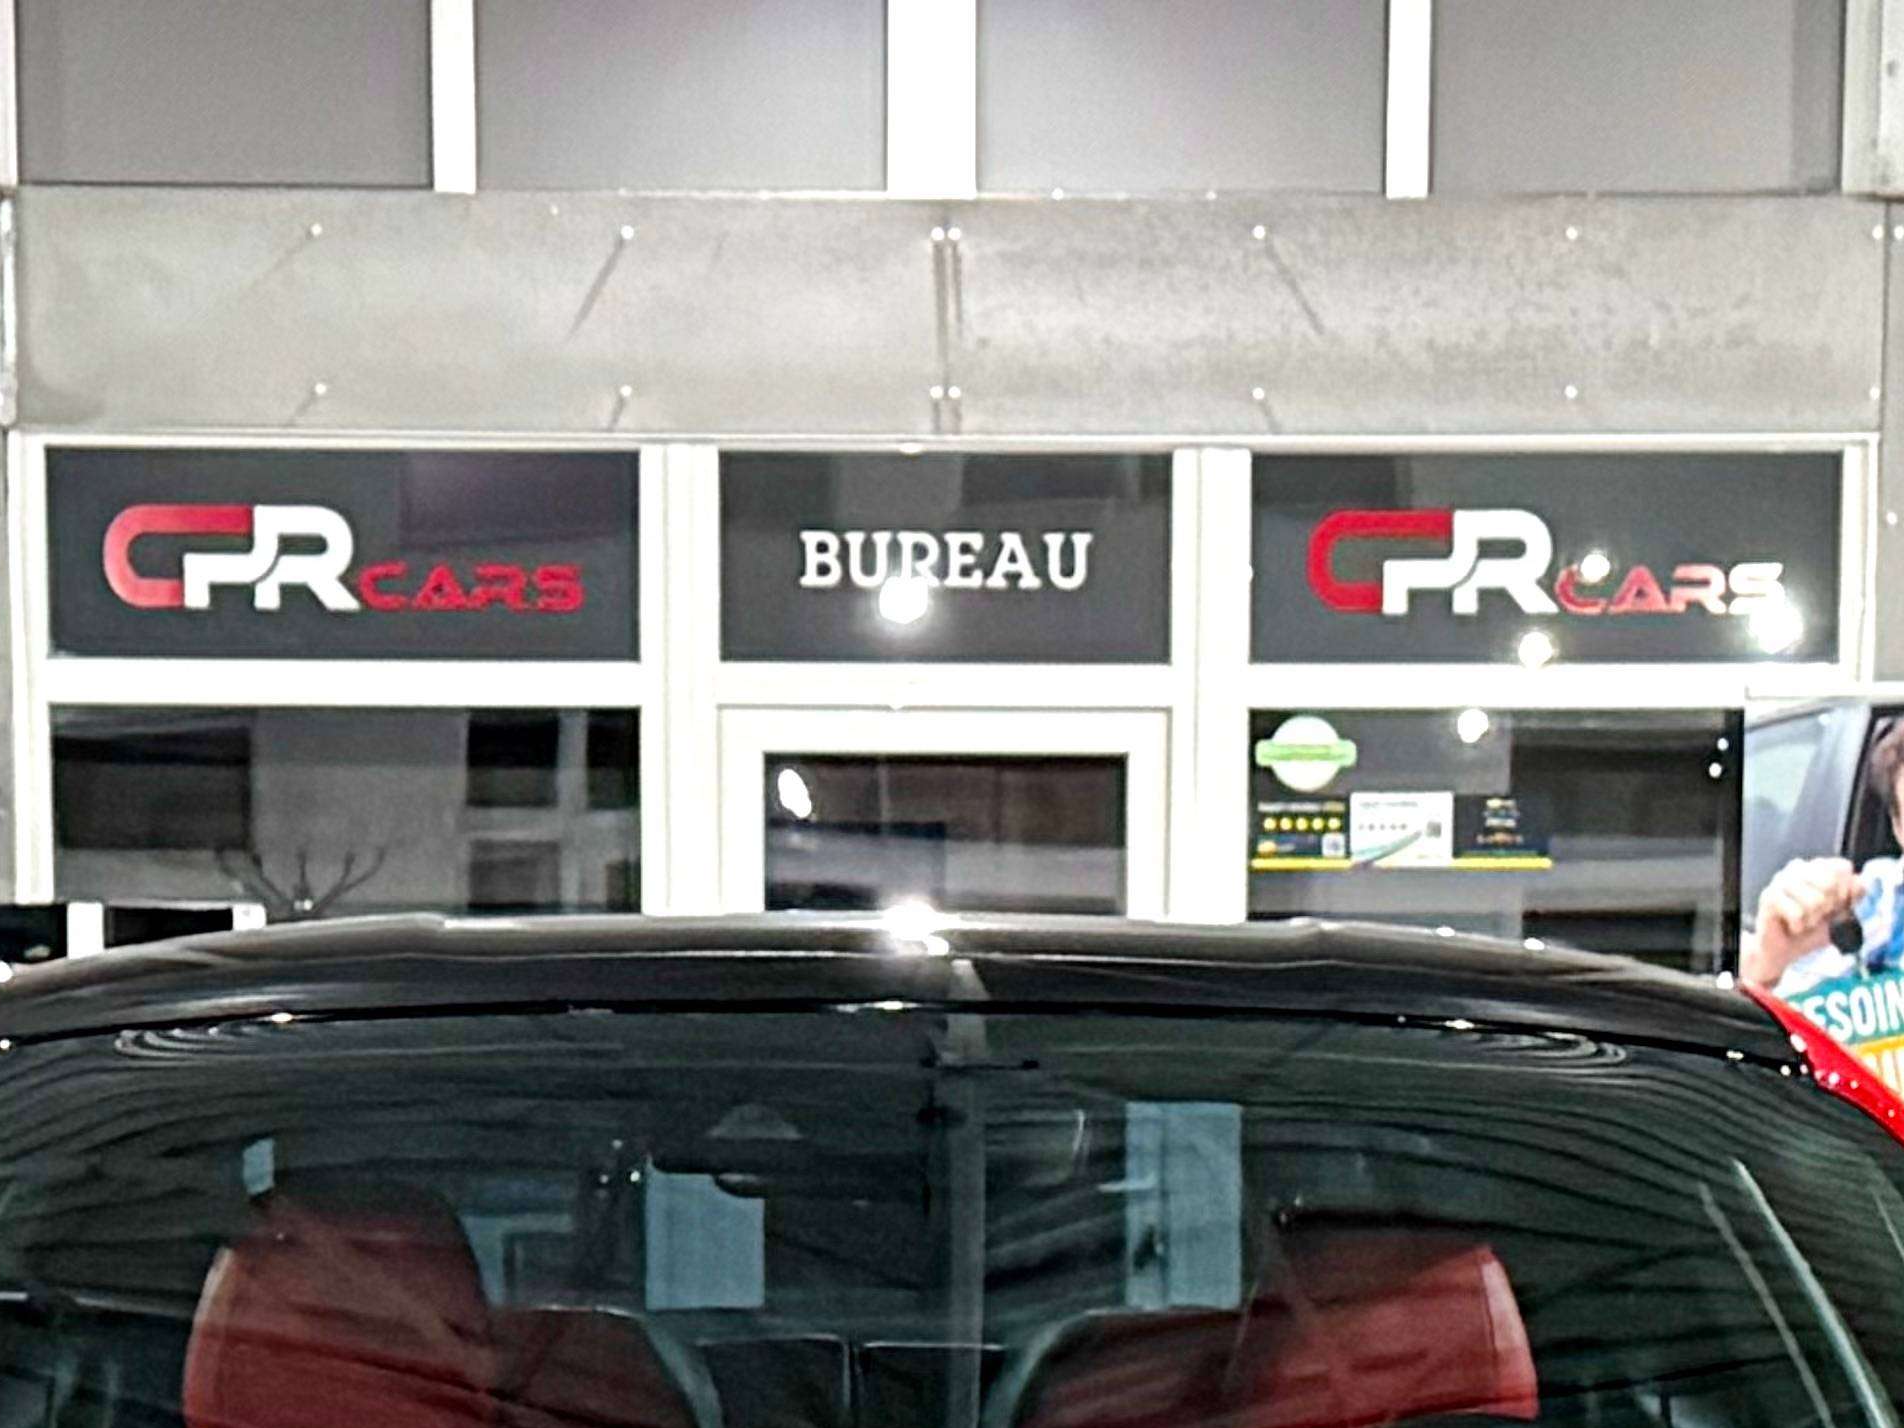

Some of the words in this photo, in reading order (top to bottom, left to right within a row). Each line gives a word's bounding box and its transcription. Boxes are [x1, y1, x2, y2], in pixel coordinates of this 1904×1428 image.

[102, 503, 361, 611] CPR
[359, 563, 586, 612] CARS
[799, 530, 1094, 590] BUREAU
[1306, 508, 1558, 615] CPR
[1554, 561, 1786, 615] CARS
